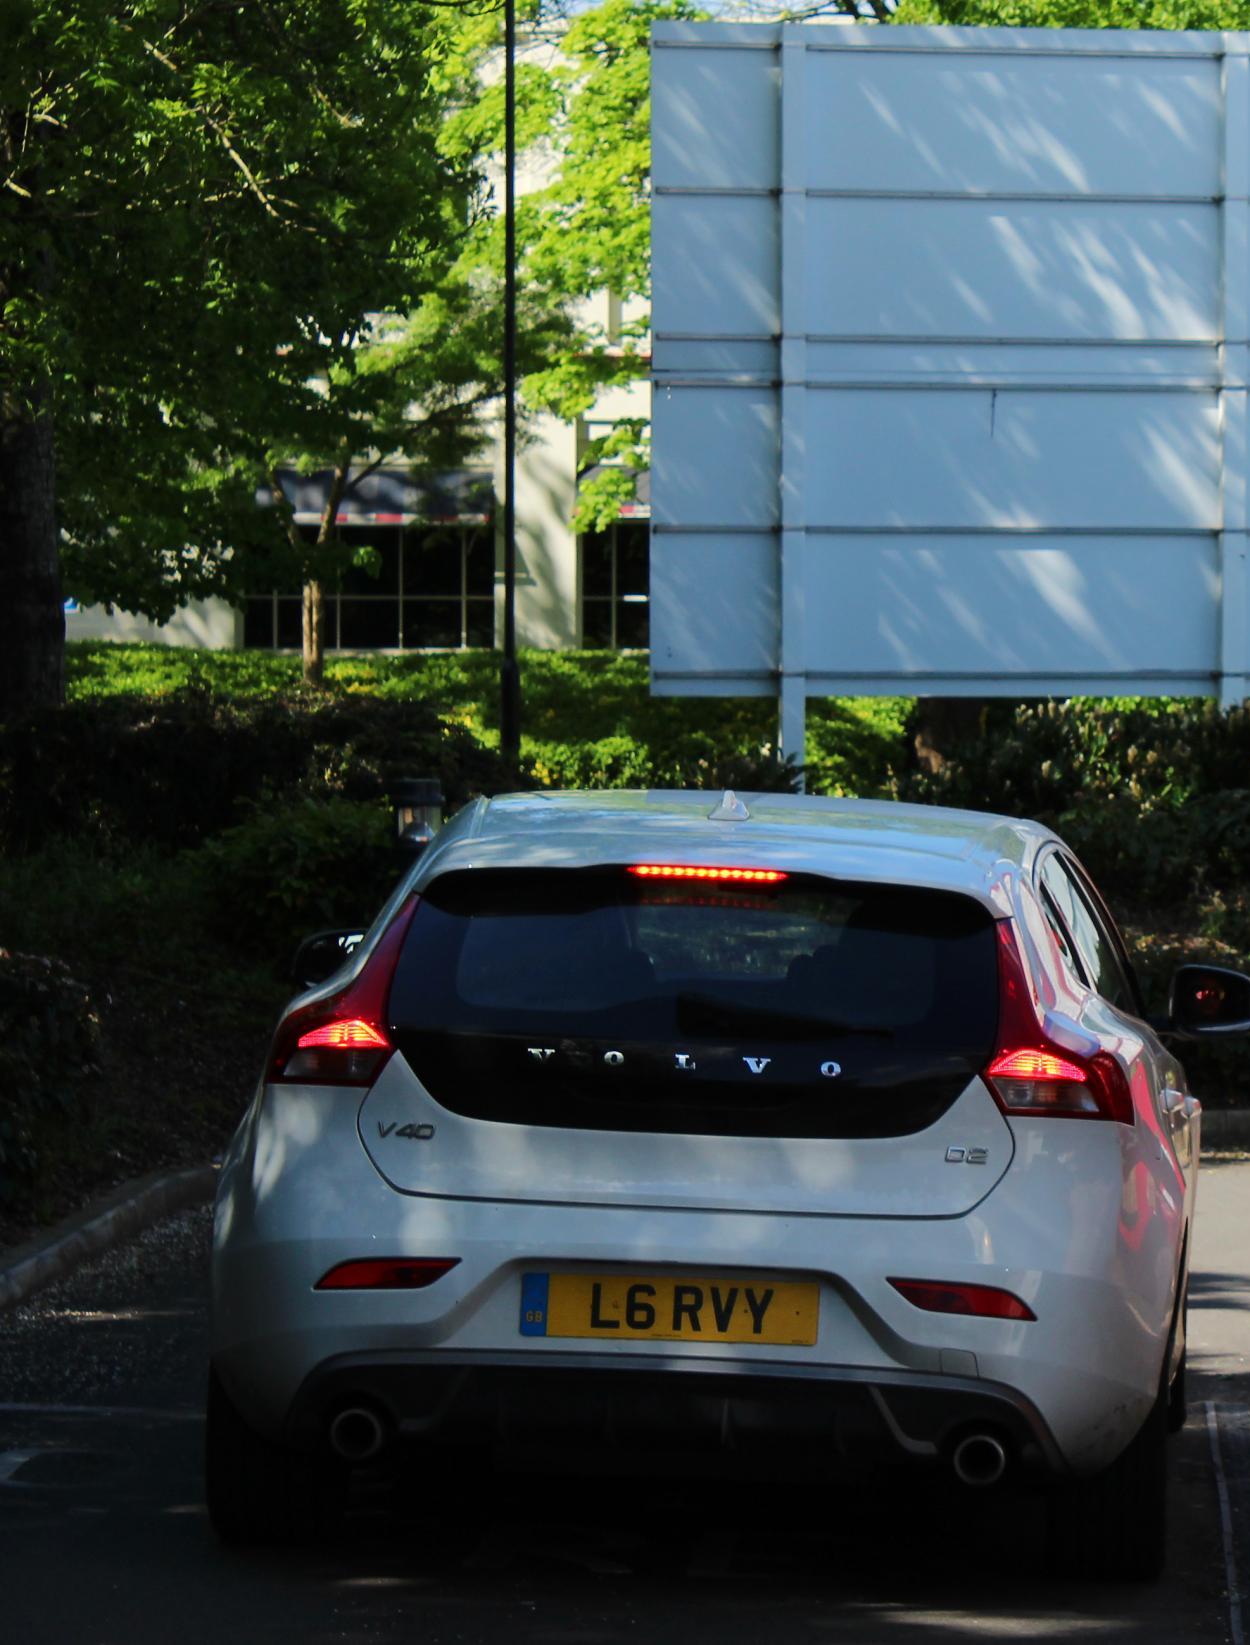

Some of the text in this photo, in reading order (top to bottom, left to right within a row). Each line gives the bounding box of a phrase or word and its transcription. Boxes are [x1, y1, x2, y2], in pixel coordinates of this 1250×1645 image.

[527, 1047, 842, 1077] VOLVO
[377, 1120, 436, 1140] V40
[944, 1146, 989, 1165] D2
[590, 1282, 774, 1335] L6 RVY
